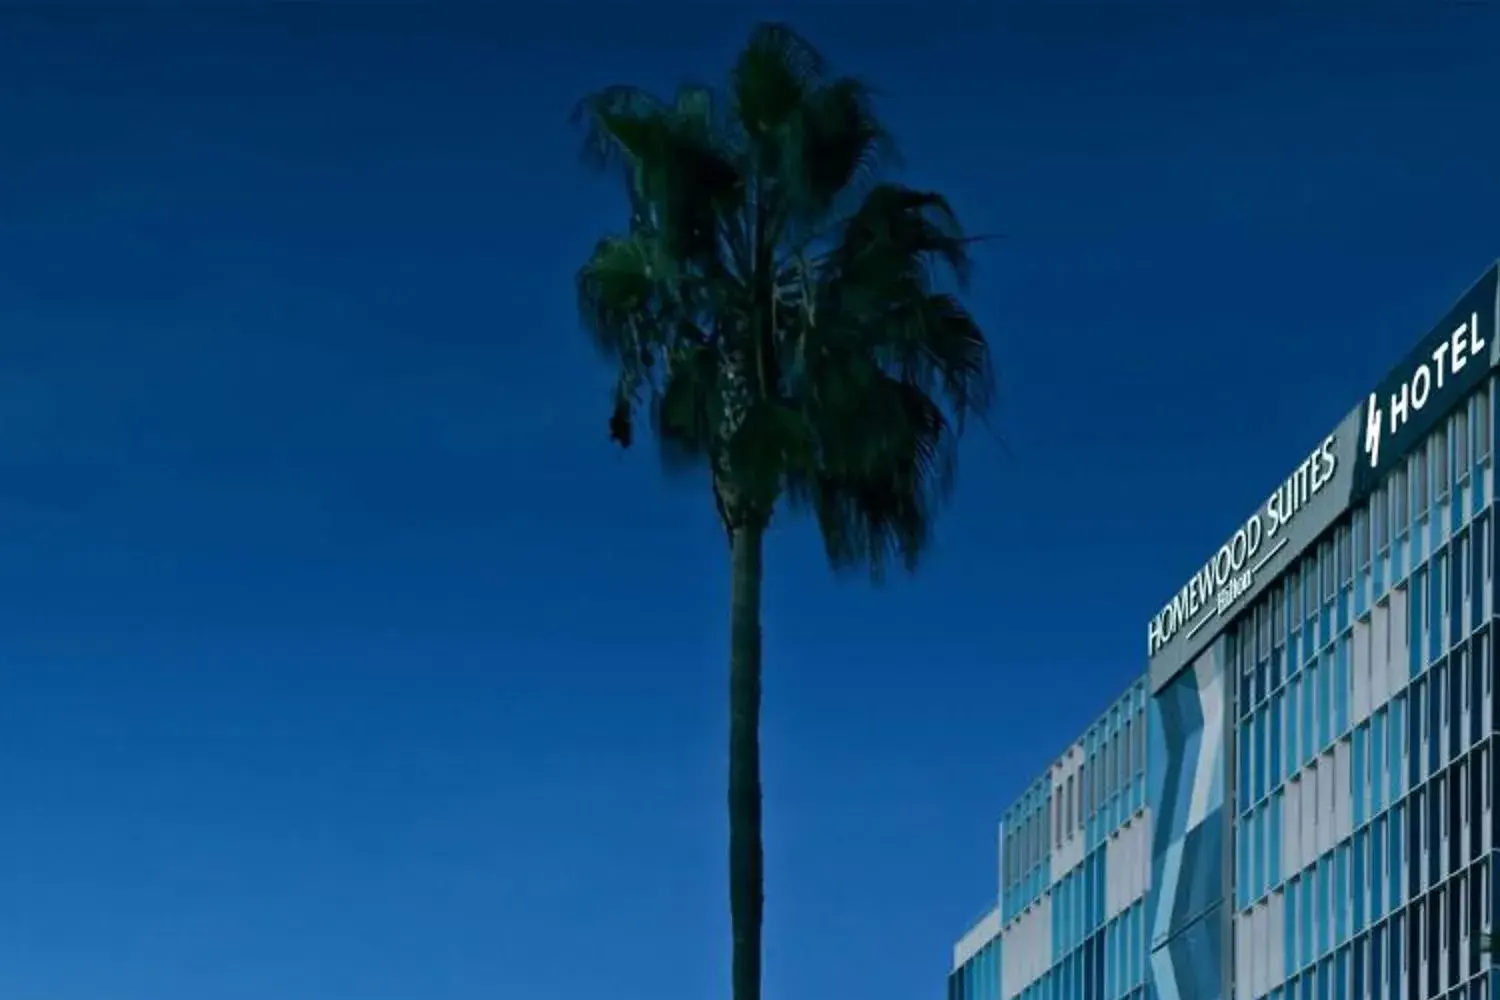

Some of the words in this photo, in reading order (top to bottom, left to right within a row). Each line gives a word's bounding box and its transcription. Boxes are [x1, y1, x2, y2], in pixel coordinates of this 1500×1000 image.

[1390, 311, 1486, 434] HOTEL
[1147, 513, 1262, 658] HOMEWOOD
[1266, 434, 1337, 537] SUITES
